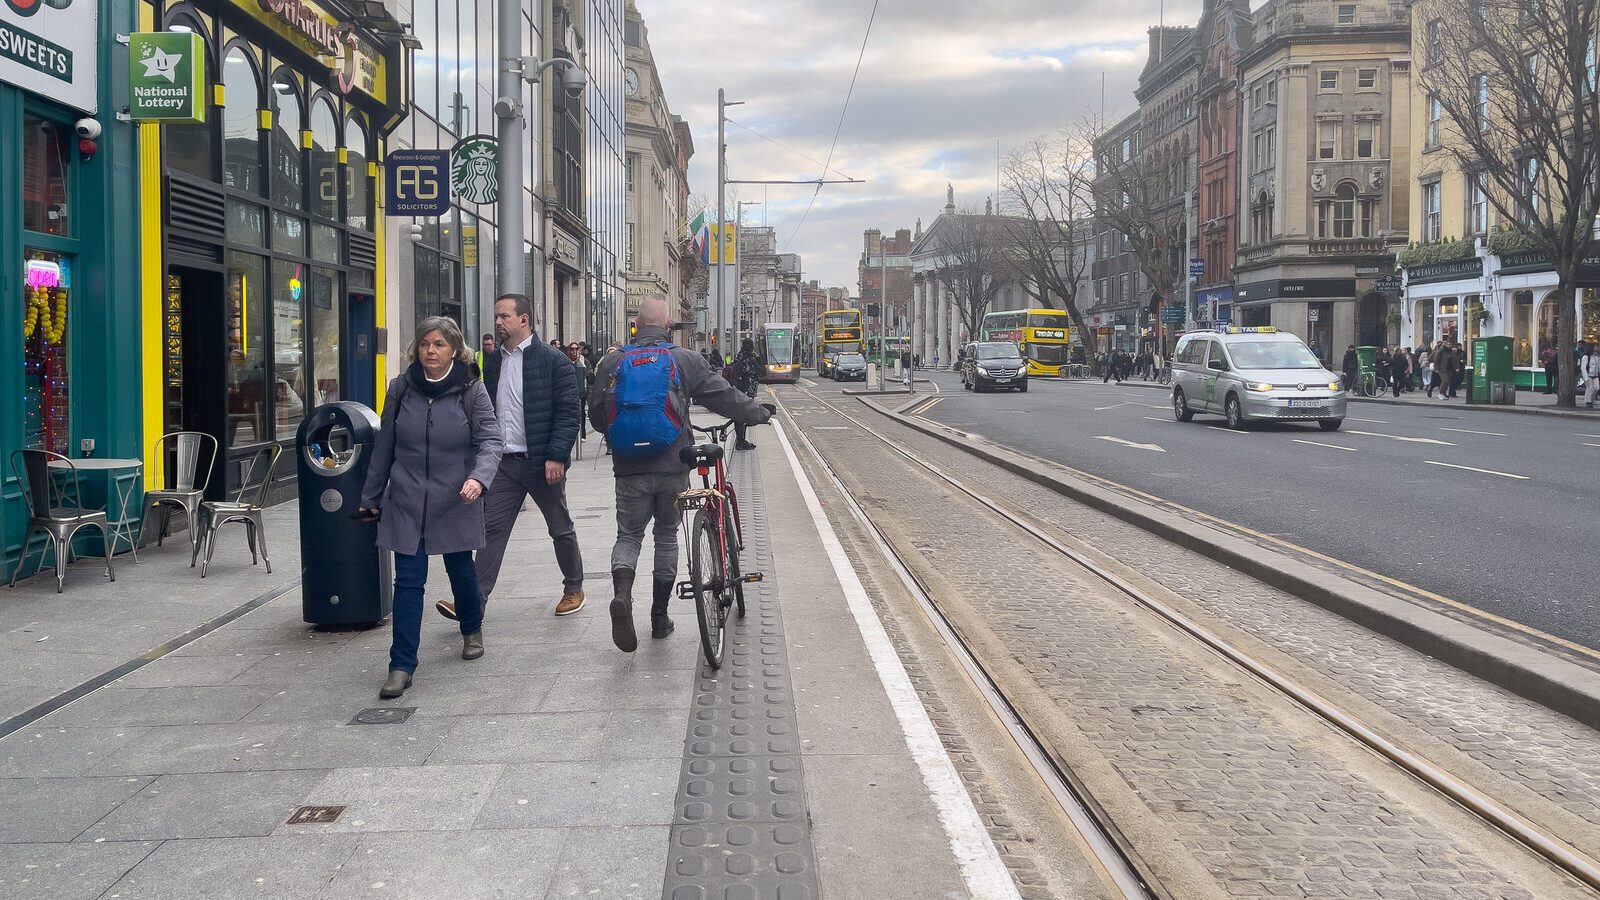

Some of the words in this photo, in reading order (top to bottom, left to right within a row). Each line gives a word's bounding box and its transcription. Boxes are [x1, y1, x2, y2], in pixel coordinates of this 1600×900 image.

[0, 27, 67, 74] SWEETS
[134, 86, 188, 97] National
[138, 97, 184, 110] Lottery
[713, 233, 732, 242] YS
[1449, 262, 1475, 273] IRELAND
[27, 267, 58, 291] open
